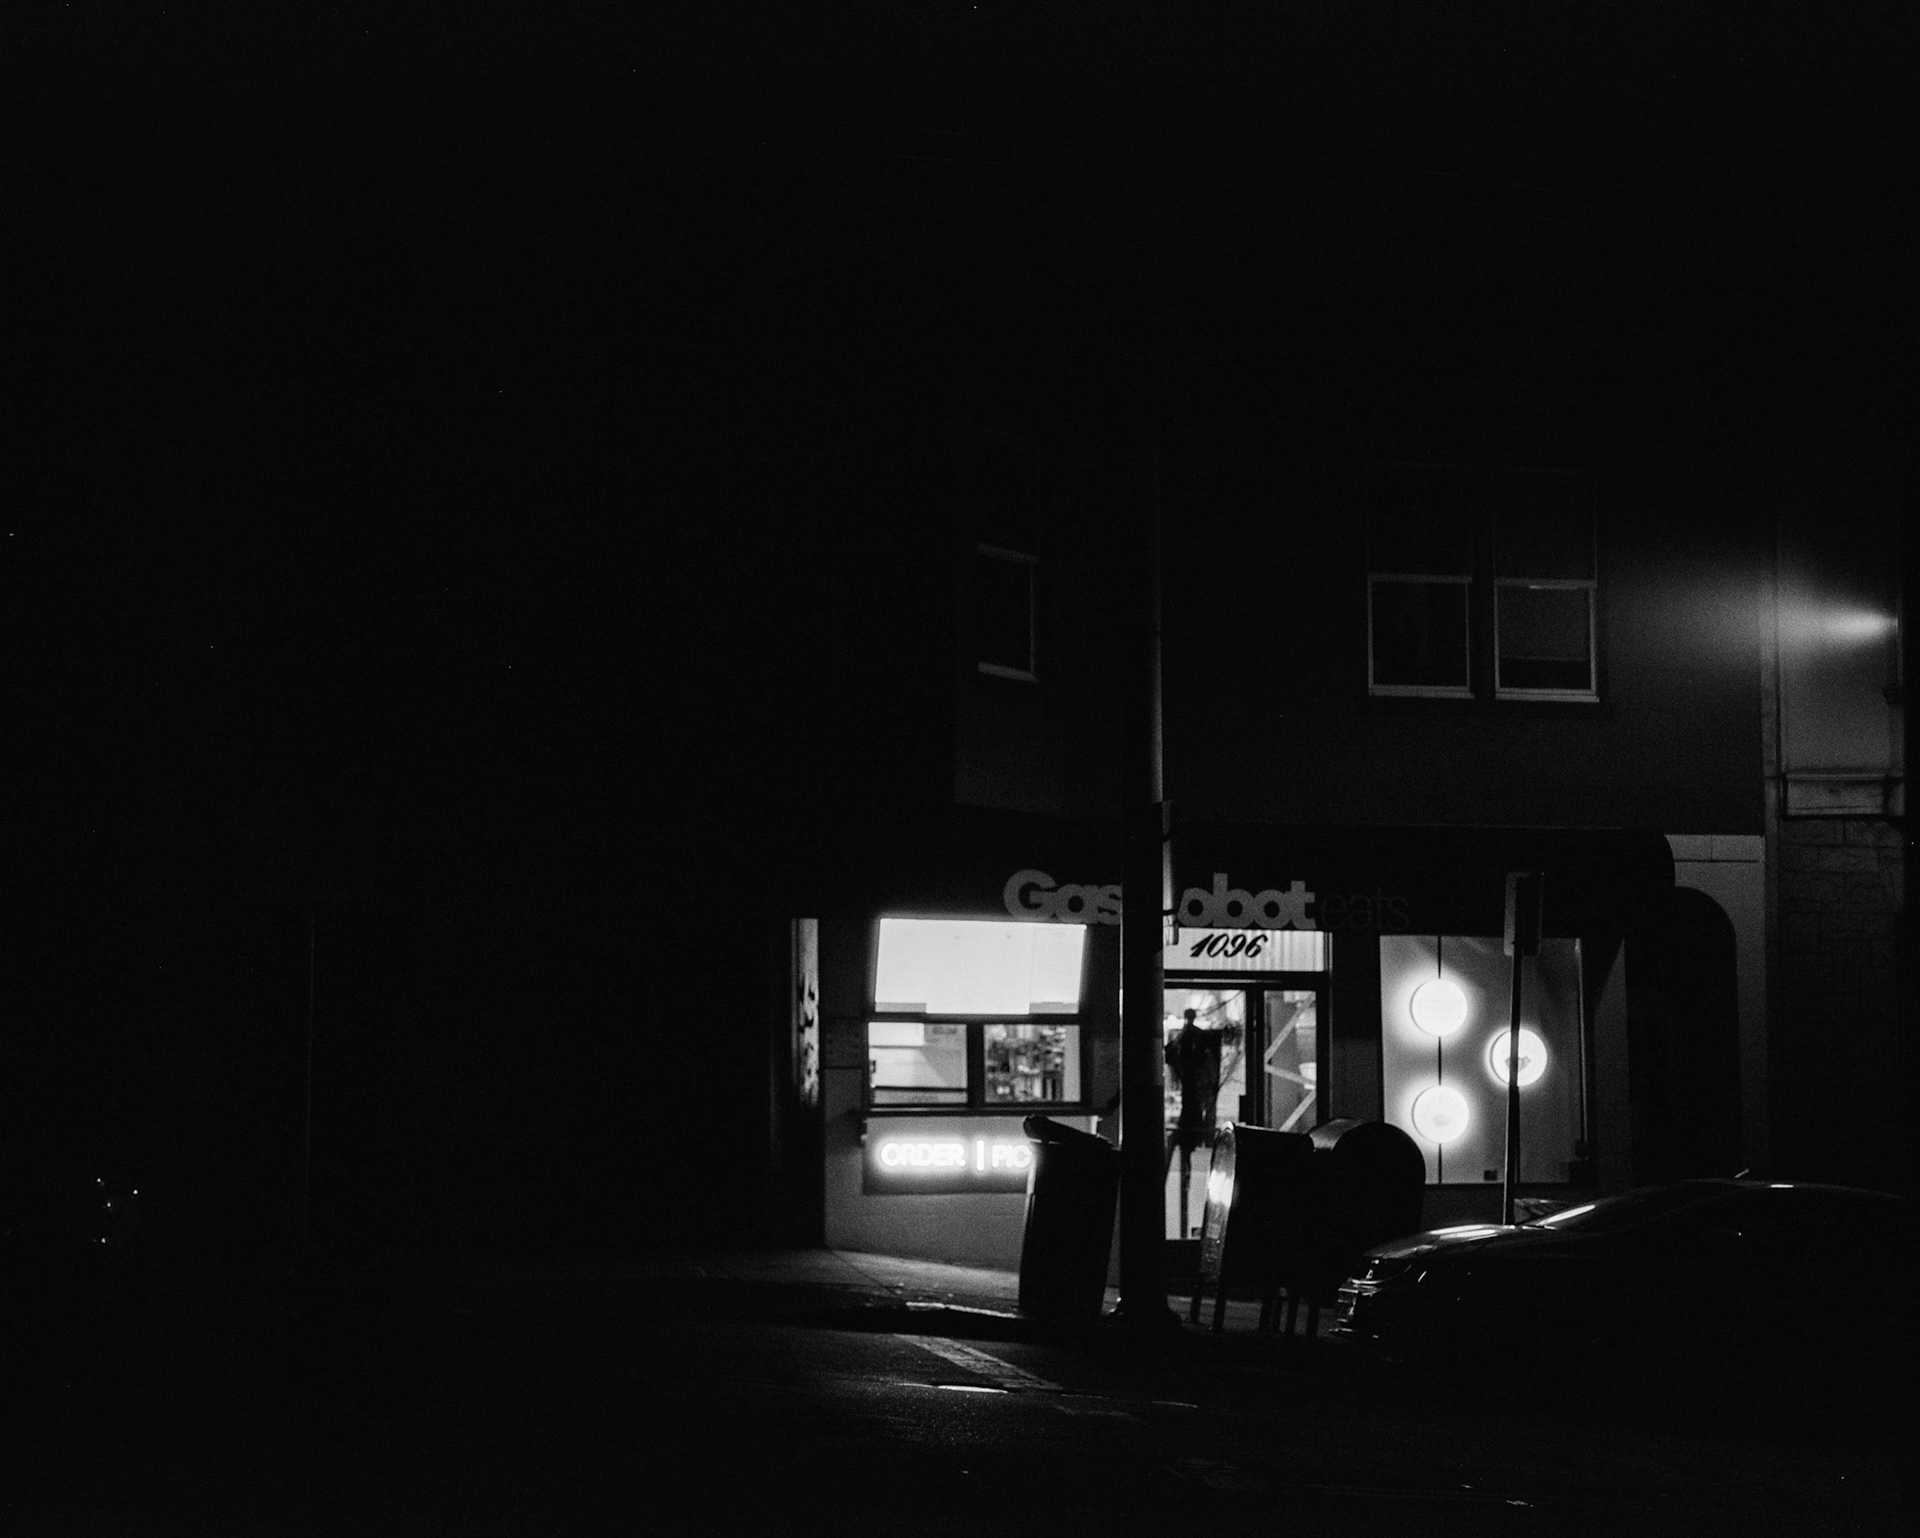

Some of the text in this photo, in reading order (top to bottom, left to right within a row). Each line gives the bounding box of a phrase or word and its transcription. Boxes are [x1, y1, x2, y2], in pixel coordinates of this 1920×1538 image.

[1003, 868, 1411, 931] Gasobot eats
[1190, 933, 1268, 958] 1096
[881, 1142, 966, 1167] ORDER
